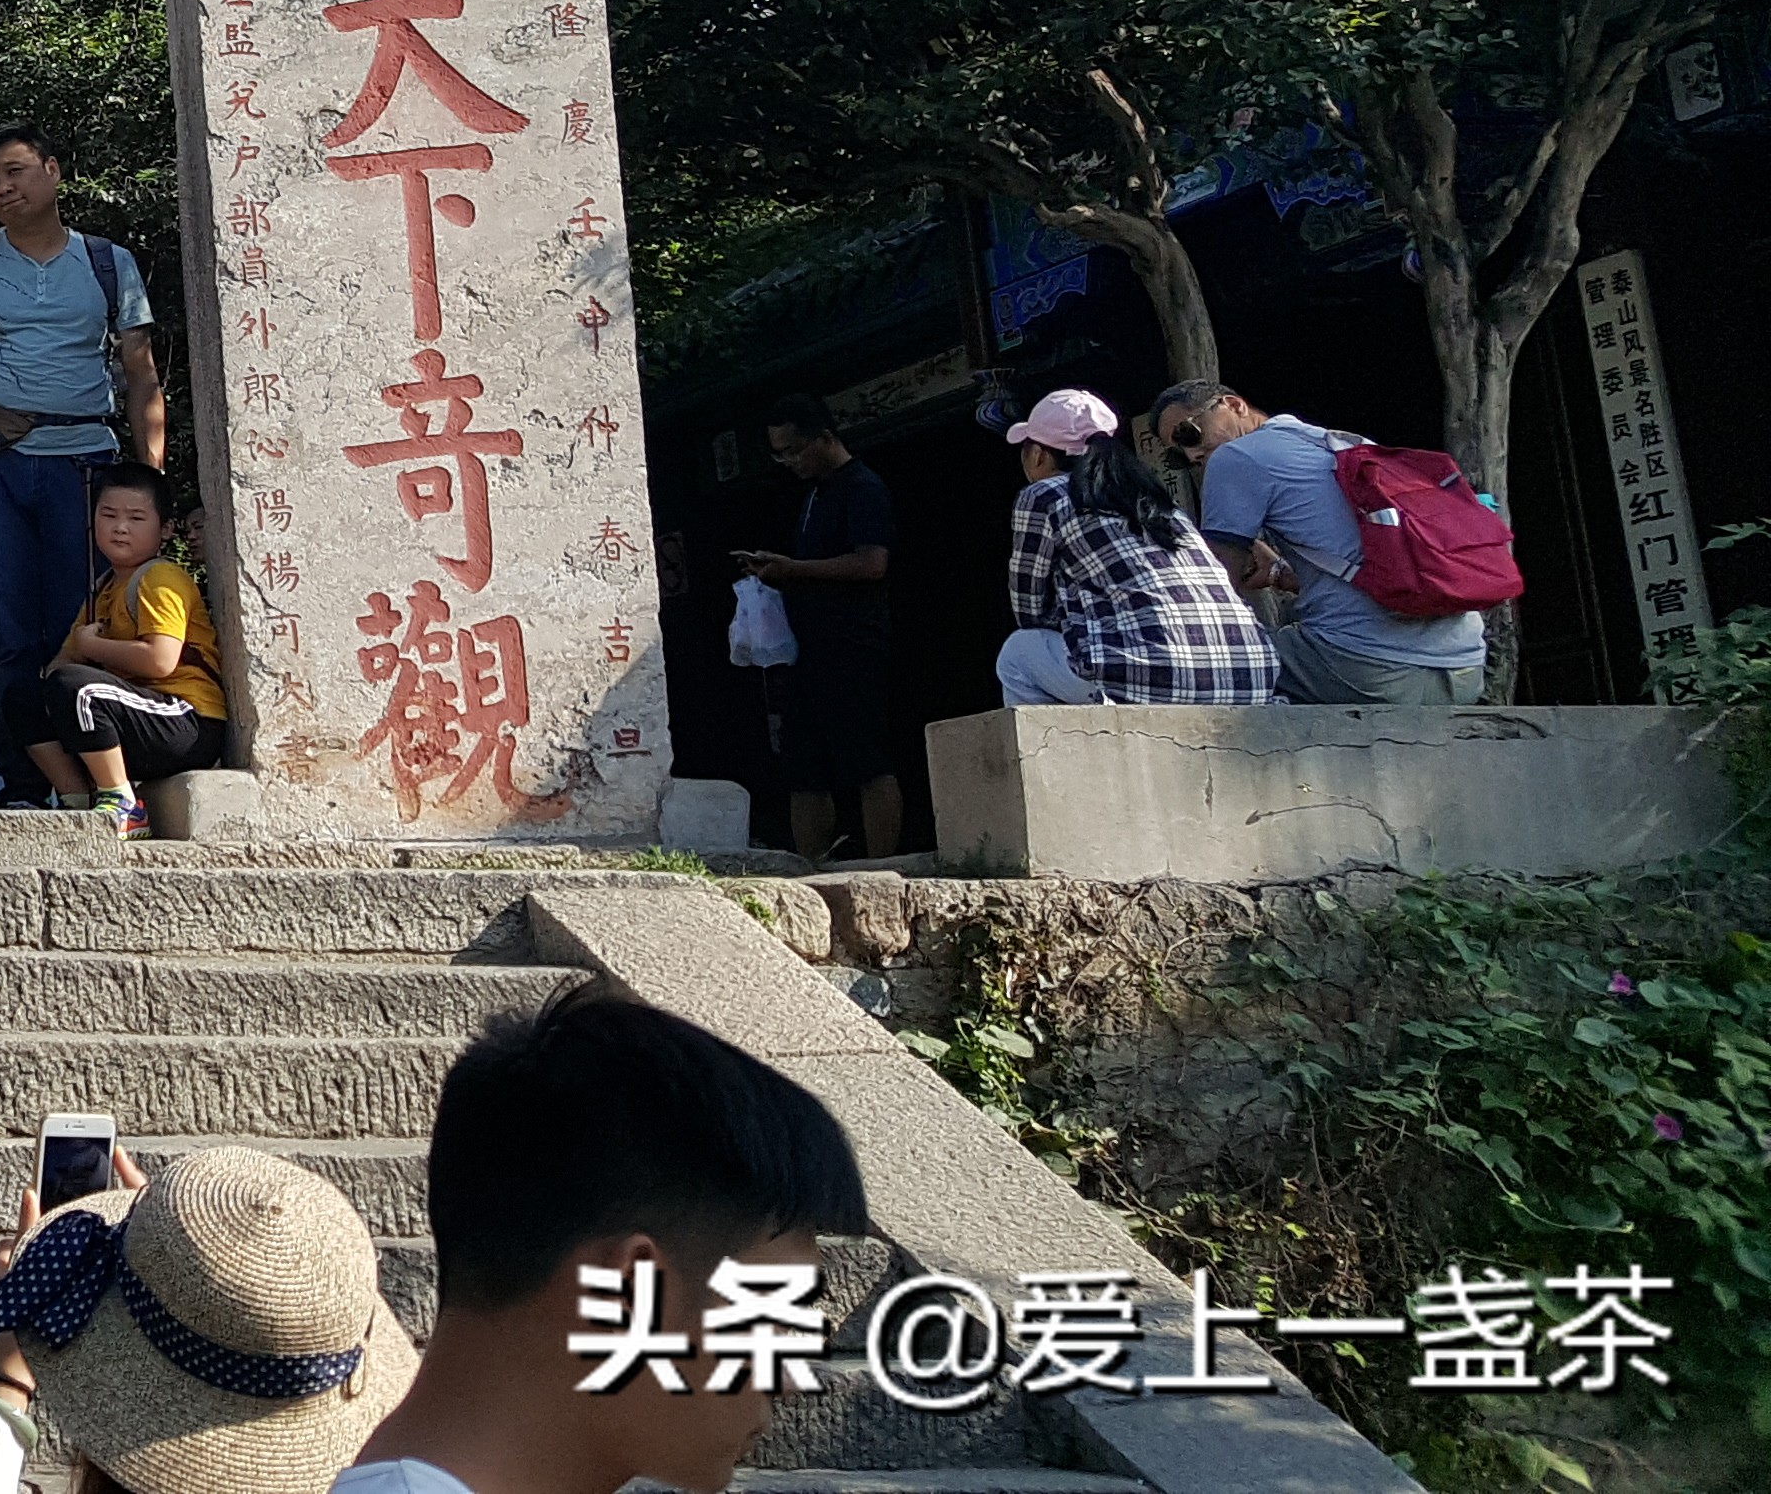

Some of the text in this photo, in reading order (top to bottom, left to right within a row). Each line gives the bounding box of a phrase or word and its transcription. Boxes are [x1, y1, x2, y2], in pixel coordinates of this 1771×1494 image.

[1585, 277, 1642, 487] 管理委员会
[1610, 269, 1669, 479] 泰山风景名胜区
[1630, 489, 1702, 706] 红门管理区
